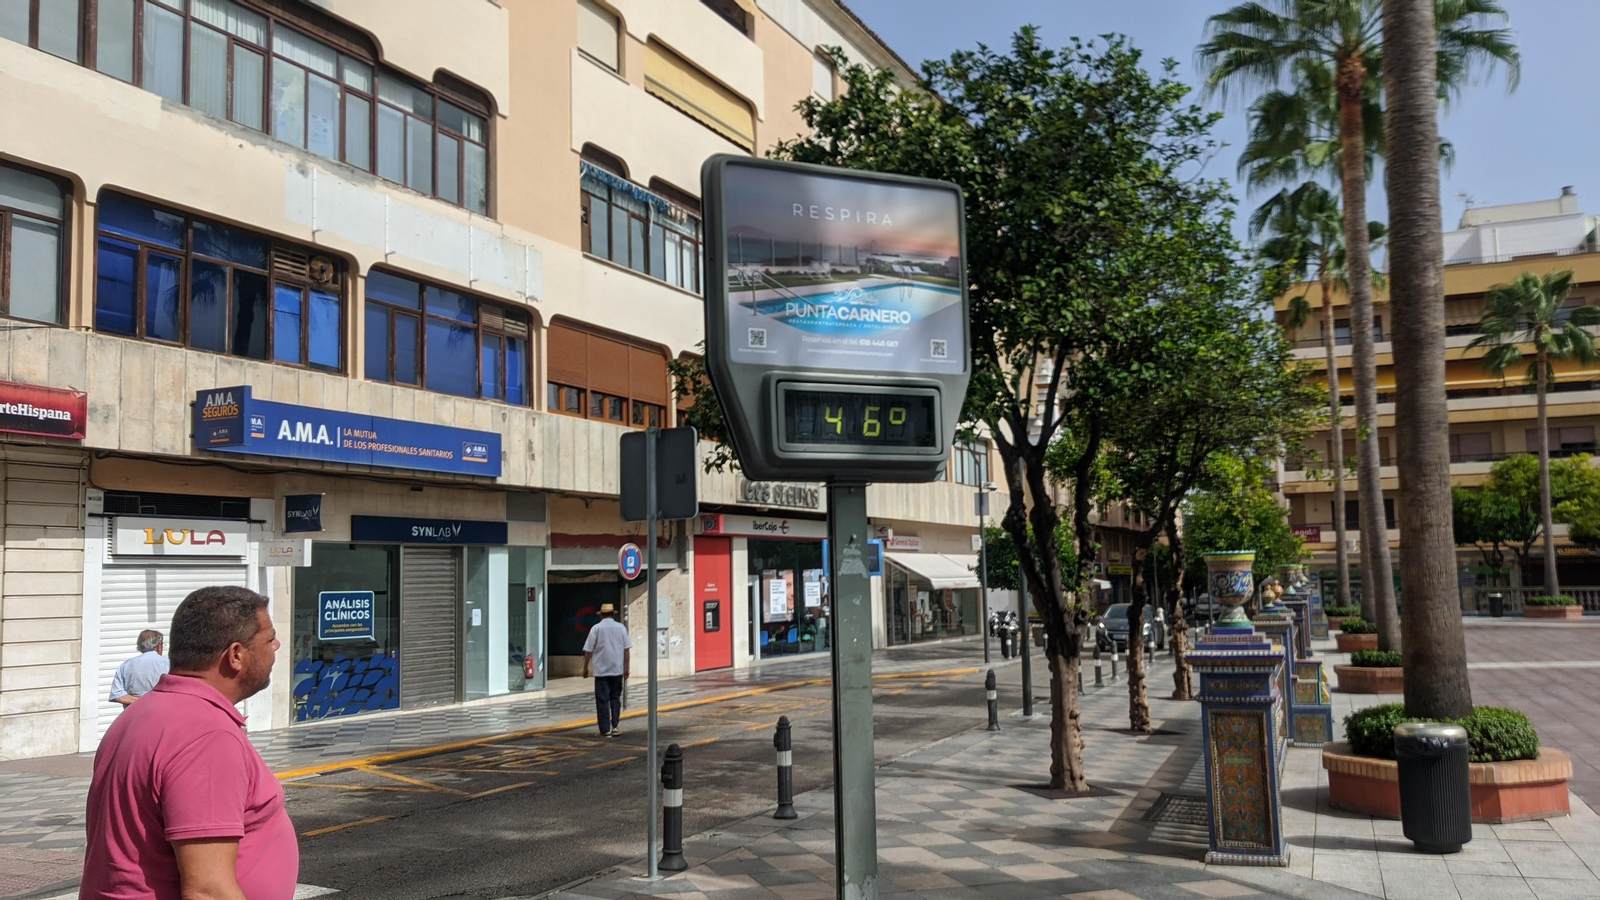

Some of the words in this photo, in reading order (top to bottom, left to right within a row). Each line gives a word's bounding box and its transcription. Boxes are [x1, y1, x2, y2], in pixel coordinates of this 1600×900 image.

[792, 203, 893, 226] RESPIRA
[785, 302, 912, 325] PUNTACARNERO
[802, 335, 832, 344] Reservas
[206, 391, 236, 407] A.M.A.
[0, 402, 72, 420] rteHispana
[202, 404, 239, 419] SEGUROS
[277, 419, 334, 445] A.M.A.
[343, 427, 352, 437] LA
[353, 429, 377, 440] MUTUA
[343, 439, 353, 448] DE
[354, 440, 367, 450] LOS
[367, 442, 418, 455] PROFESIONALES
[418, 447, 454, 460] SANITARIOS
[143, 528, 226, 546] LULA
[411, 525, 452, 538] SYNLAB
[269, 546, 293, 554] LULA
[324, 597, 370, 610] ANÁLISIS
[324, 608, 370, 621] CLÍNICOS
